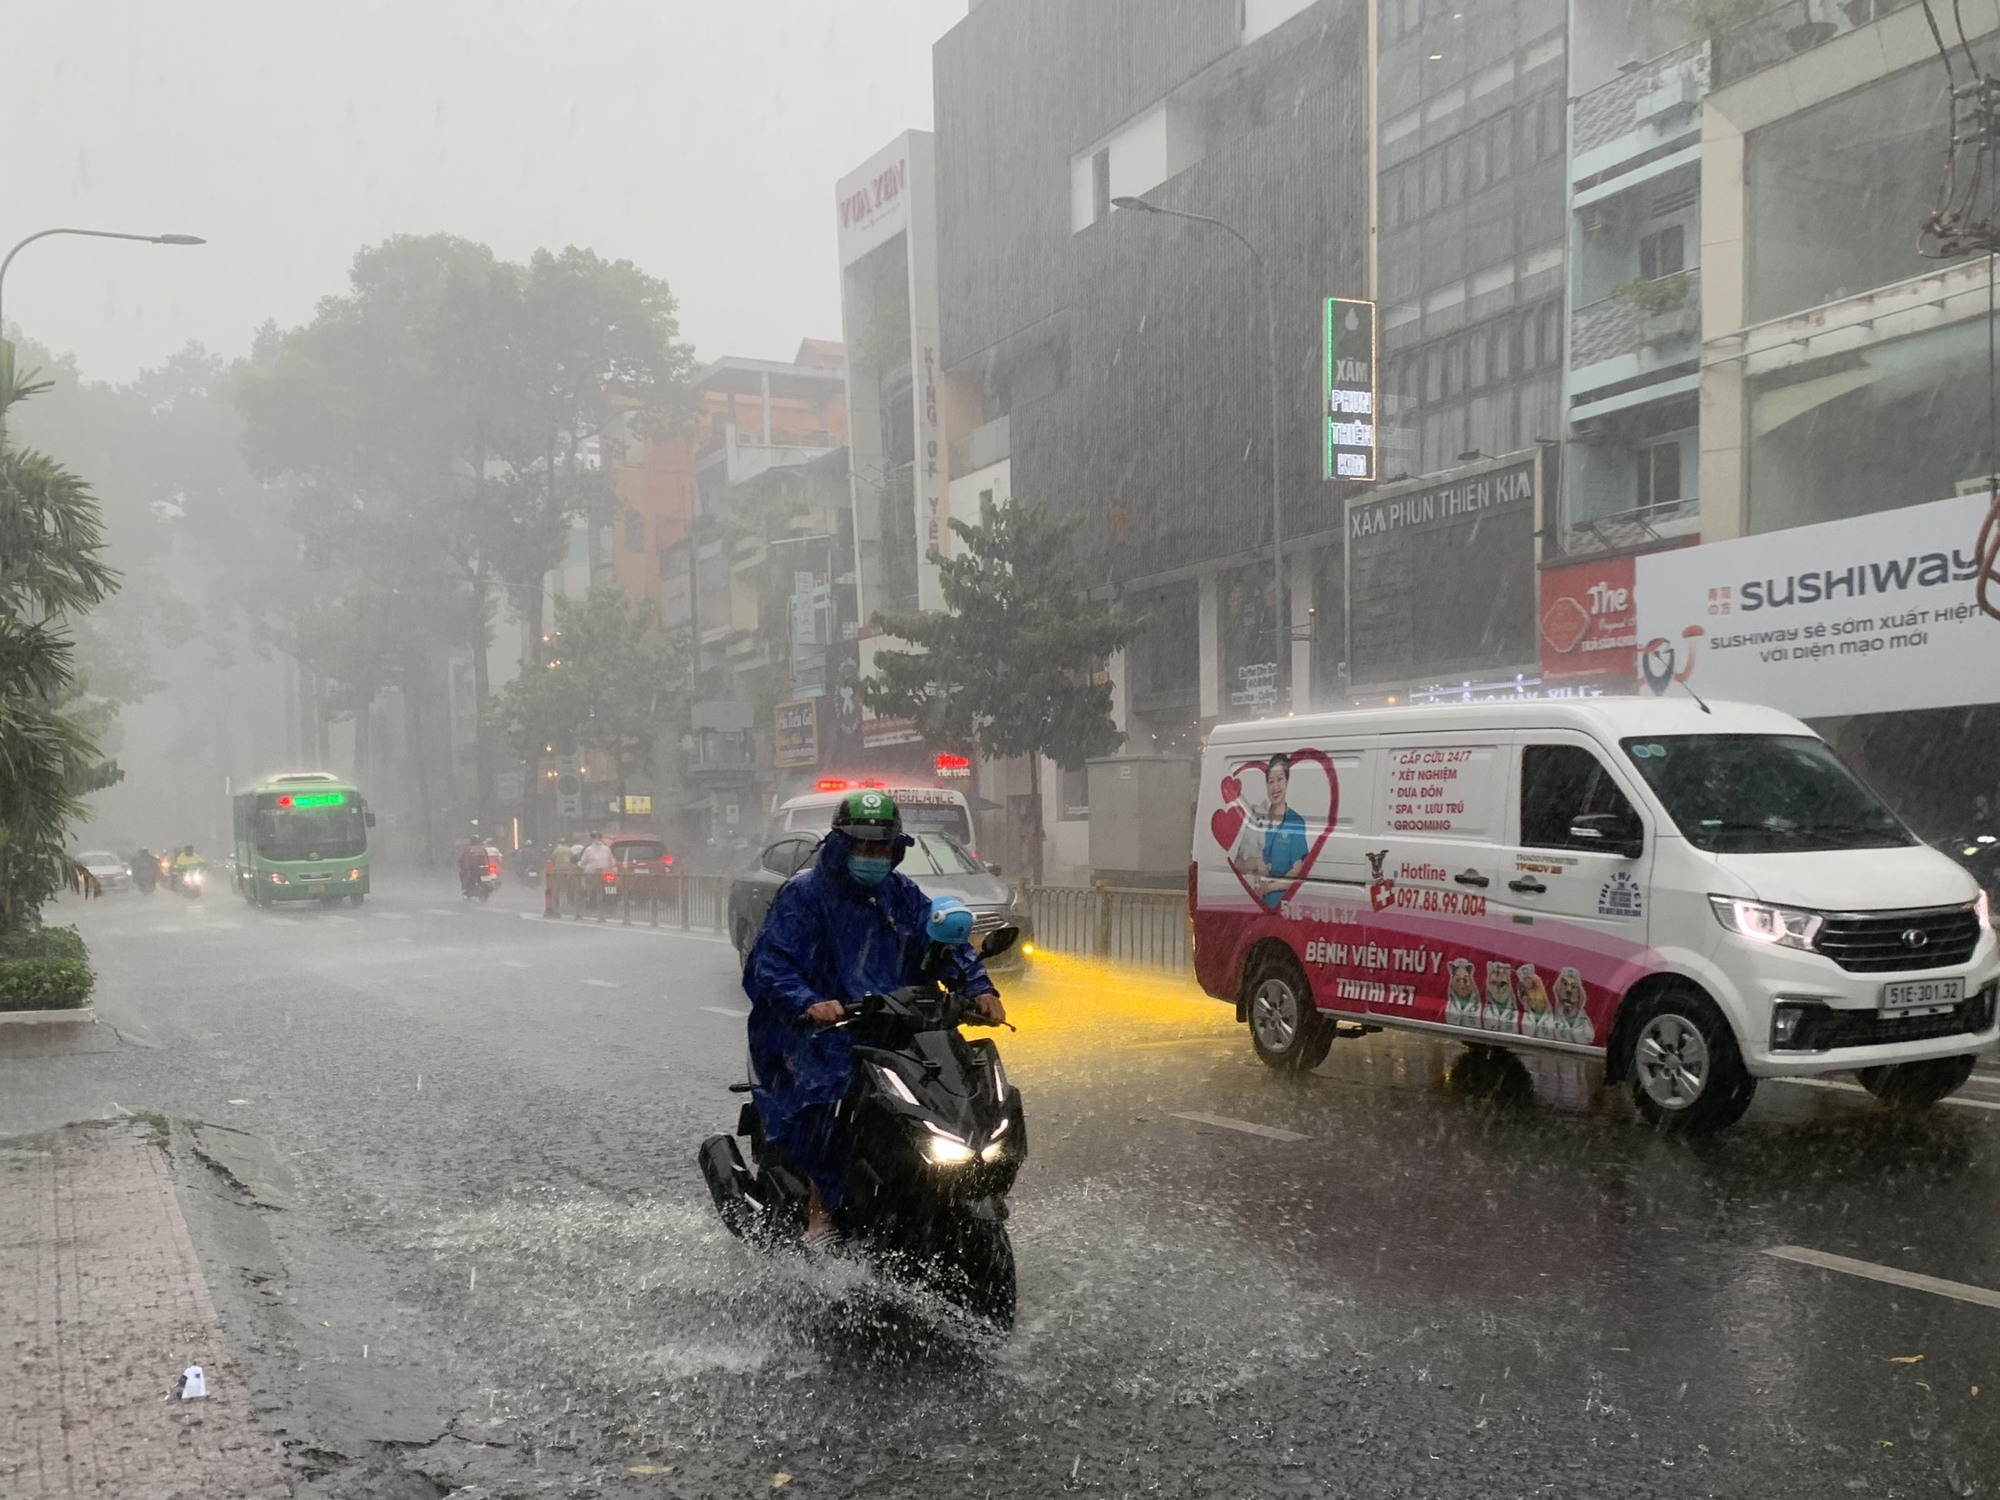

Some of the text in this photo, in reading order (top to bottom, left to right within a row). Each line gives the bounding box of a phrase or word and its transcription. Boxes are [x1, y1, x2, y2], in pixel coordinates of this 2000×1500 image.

[1331, 389, 1372, 414] PHUN
[1390, 495, 1435, 530] PHUN
[1438, 477, 1491, 518] THIÊN
[1496, 471, 1532, 504] KIM
[1587, 581, 1629, 615] The
[1446, 750, 1473, 763] 24/7
[1417, 767, 1458, 783] NGHIỆM
[884, 788, 954, 804] MBULANCE
[1395, 804, 1414, 814] SPA
[1394, 820, 1452, 831] GROOMING
[1401, 863, 1447, 881] Hotline
[1397, 887, 1487, 917] 097.88.99.004
[1305, 936, 1443, 974] BỆNH VIỆN THÚ Y
[1387, 983, 1417, 1007] PET
